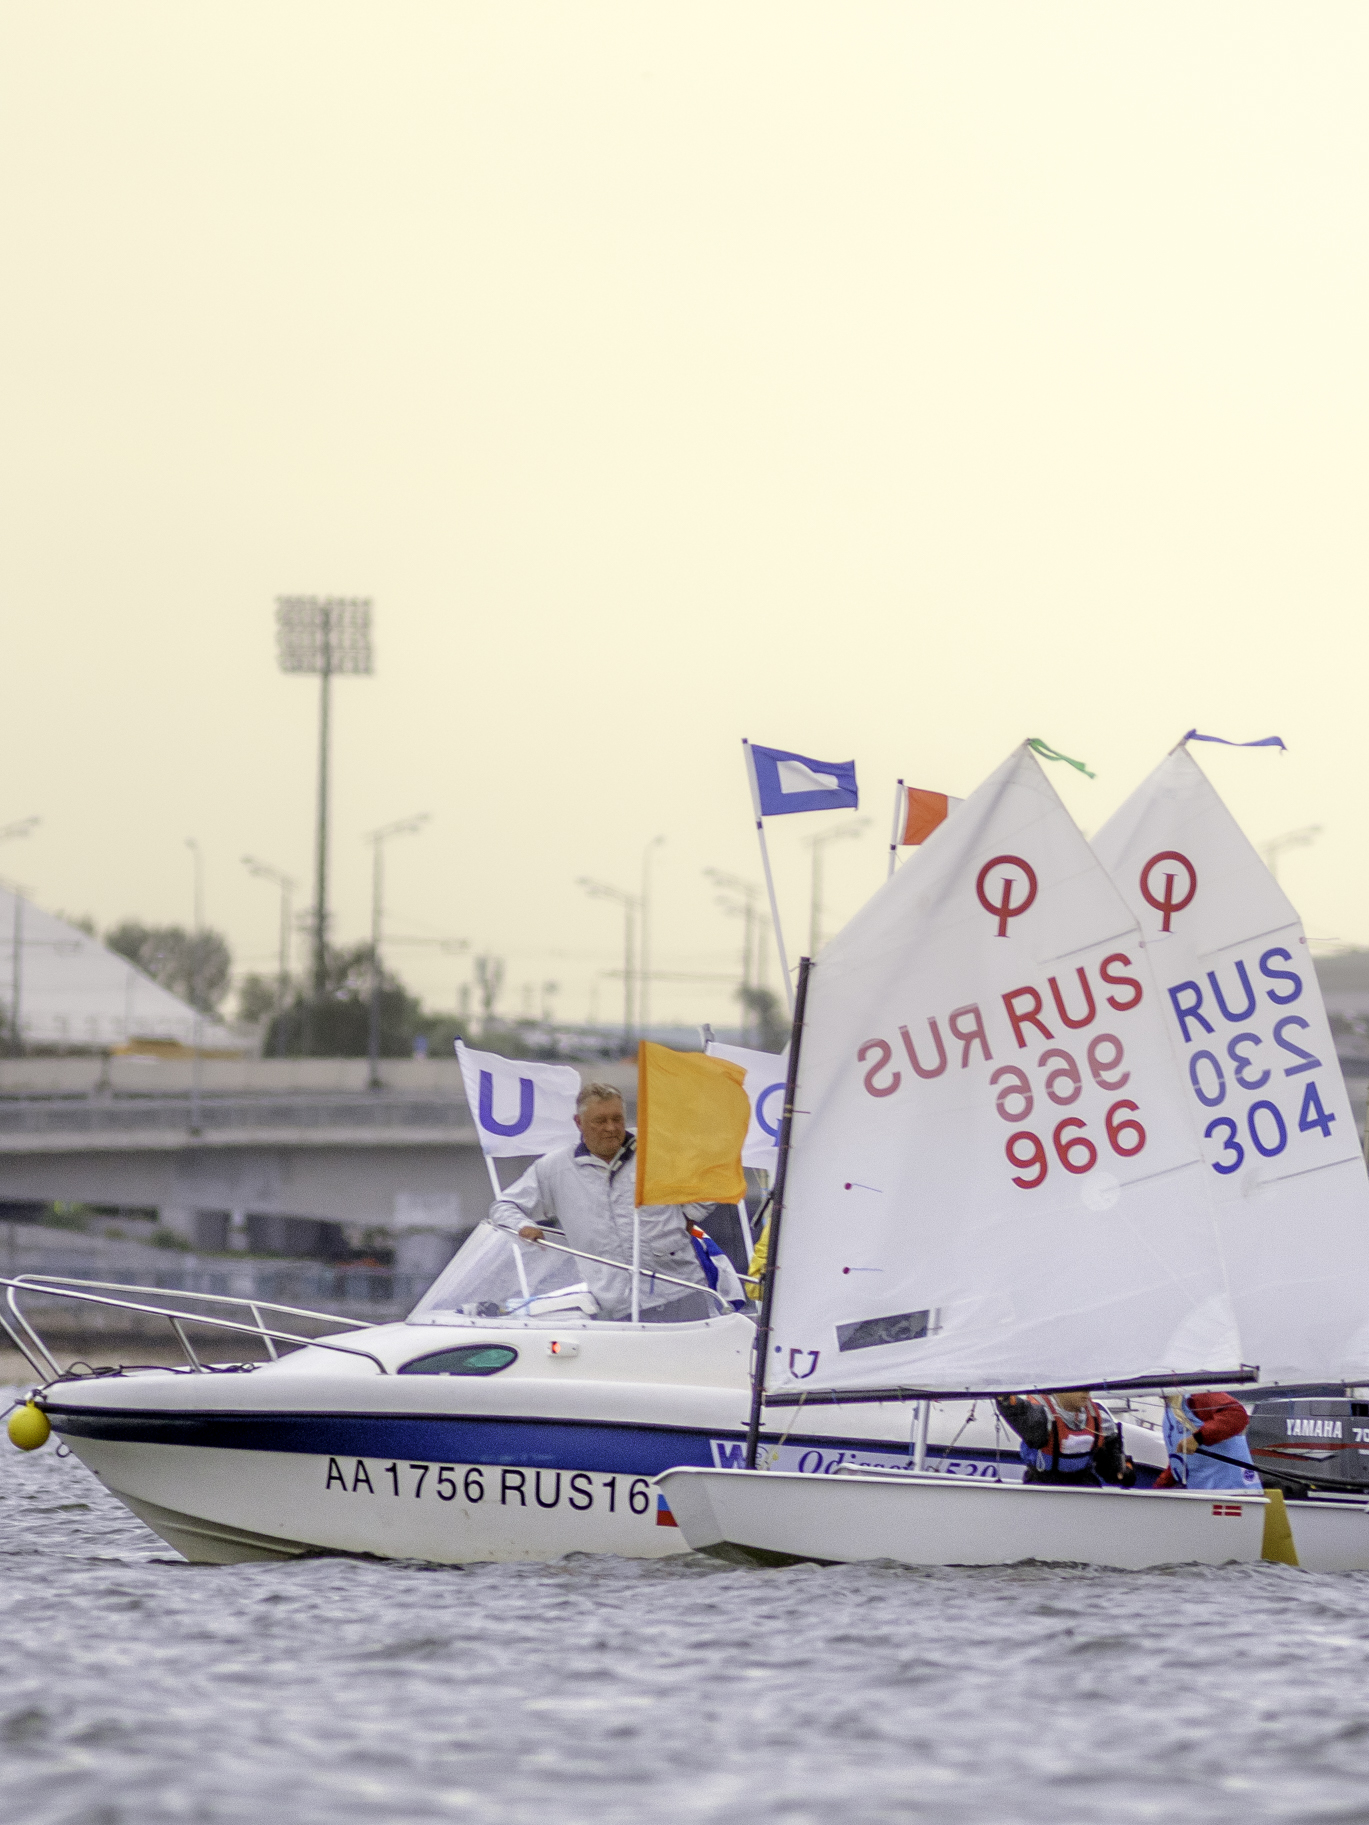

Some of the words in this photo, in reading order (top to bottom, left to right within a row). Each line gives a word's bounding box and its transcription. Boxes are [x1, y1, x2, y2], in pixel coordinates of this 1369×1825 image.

[1001, 953, 1143, 1048] RUS
[1167, 947, 1303, 1043] RUS
[479, 1069, 535, 1137] U
[1005, 1099, 1147, 1189] 966
[1204, 1081, 1337, 1174] 304
[1286, 1418, 1343, 1439] YAMAHA
